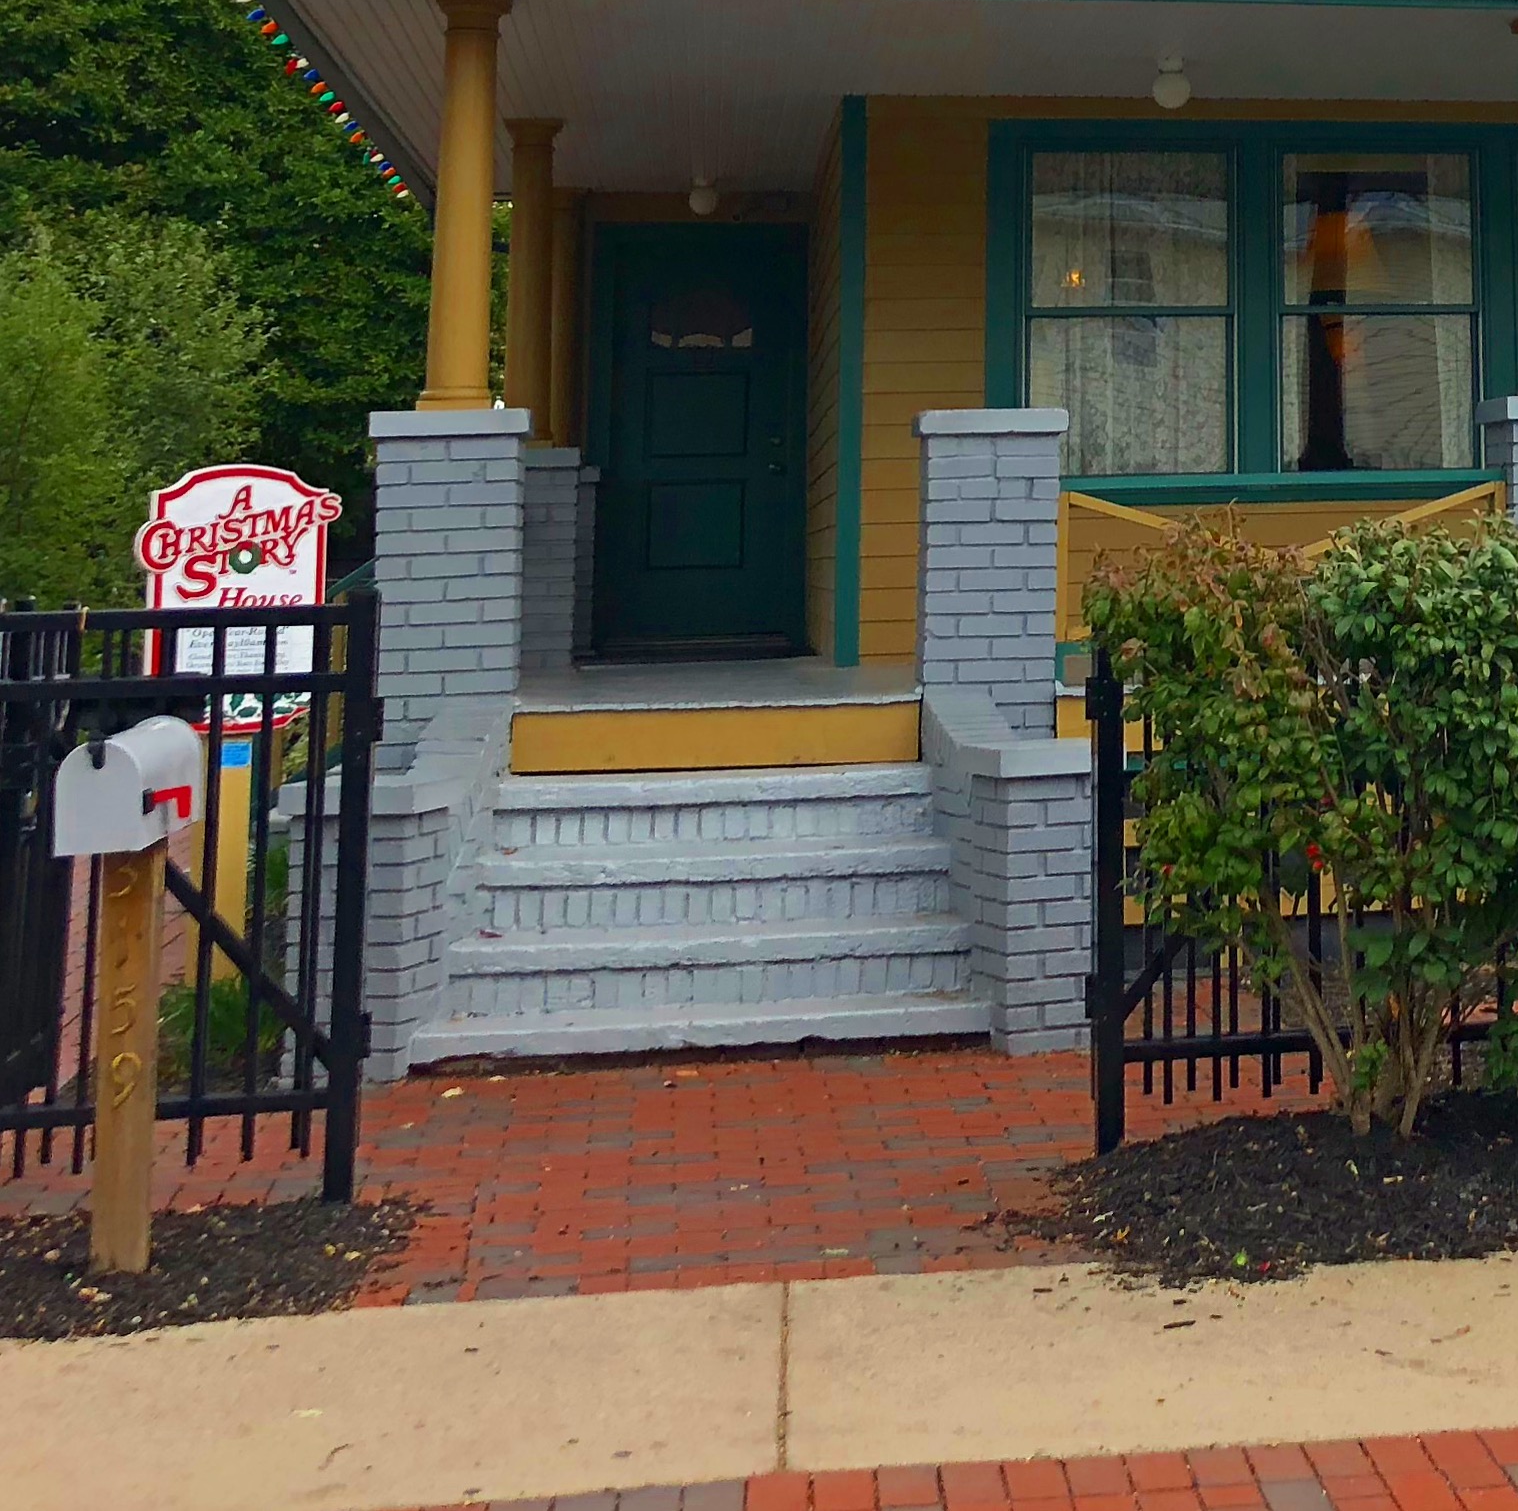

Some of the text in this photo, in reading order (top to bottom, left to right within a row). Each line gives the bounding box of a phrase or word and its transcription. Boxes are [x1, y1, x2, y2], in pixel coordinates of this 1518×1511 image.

[141, 494, 342, 571] CHRISTMAS
[218, 484, 253, 520] A
[175, 526, 309, 601] STORY
